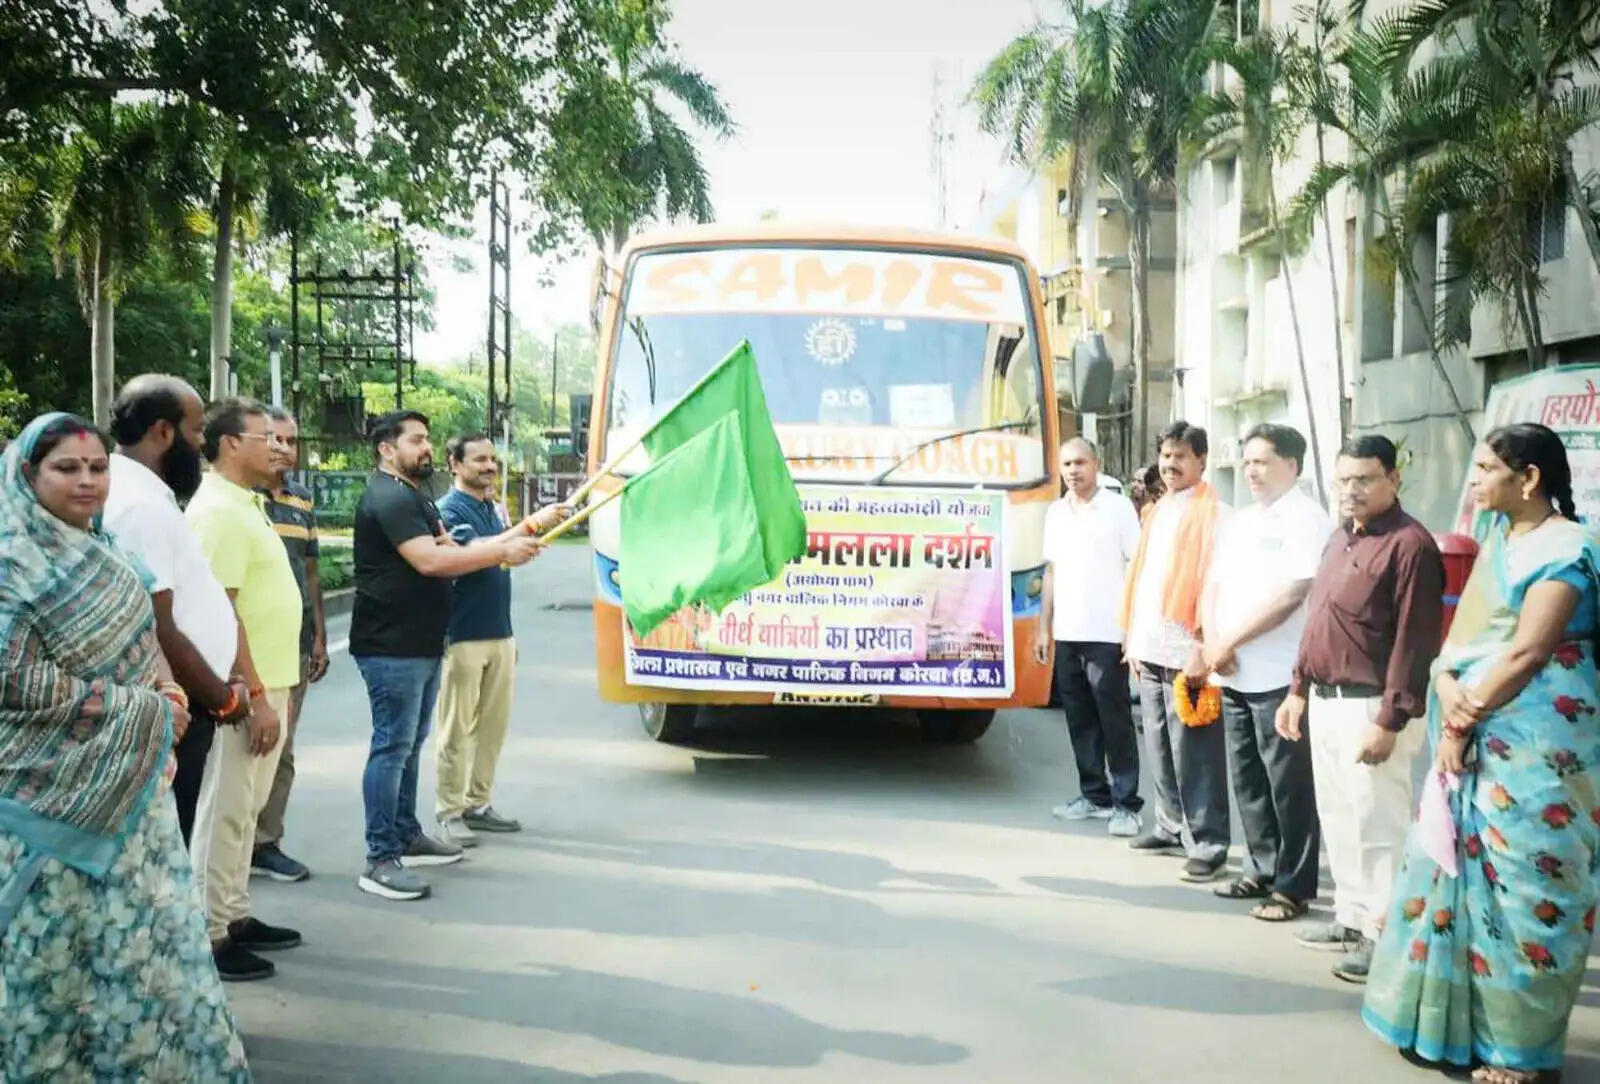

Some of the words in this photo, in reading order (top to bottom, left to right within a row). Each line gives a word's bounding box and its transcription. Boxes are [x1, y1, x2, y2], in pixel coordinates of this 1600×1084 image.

[646, 253, 1004, 315] SAMIR
[786, 531, 914, 566] मलला
[923, 522, 994, 569] दर्शन
[718, 611, 755, 646] तीर्थ
[824, 626, 850, 650] का
[854, 626, 914, 653] प्रस्थान
[664, 657, 722, 677] प्रशासन
[725, 657, 749, 680] एवं
[751, 662, 789, 680] नगर
[791, 660, 847, 682] पालिक
[849, 662, 896, 683] निगम
[899, 662, 949, 684] कोरबा
